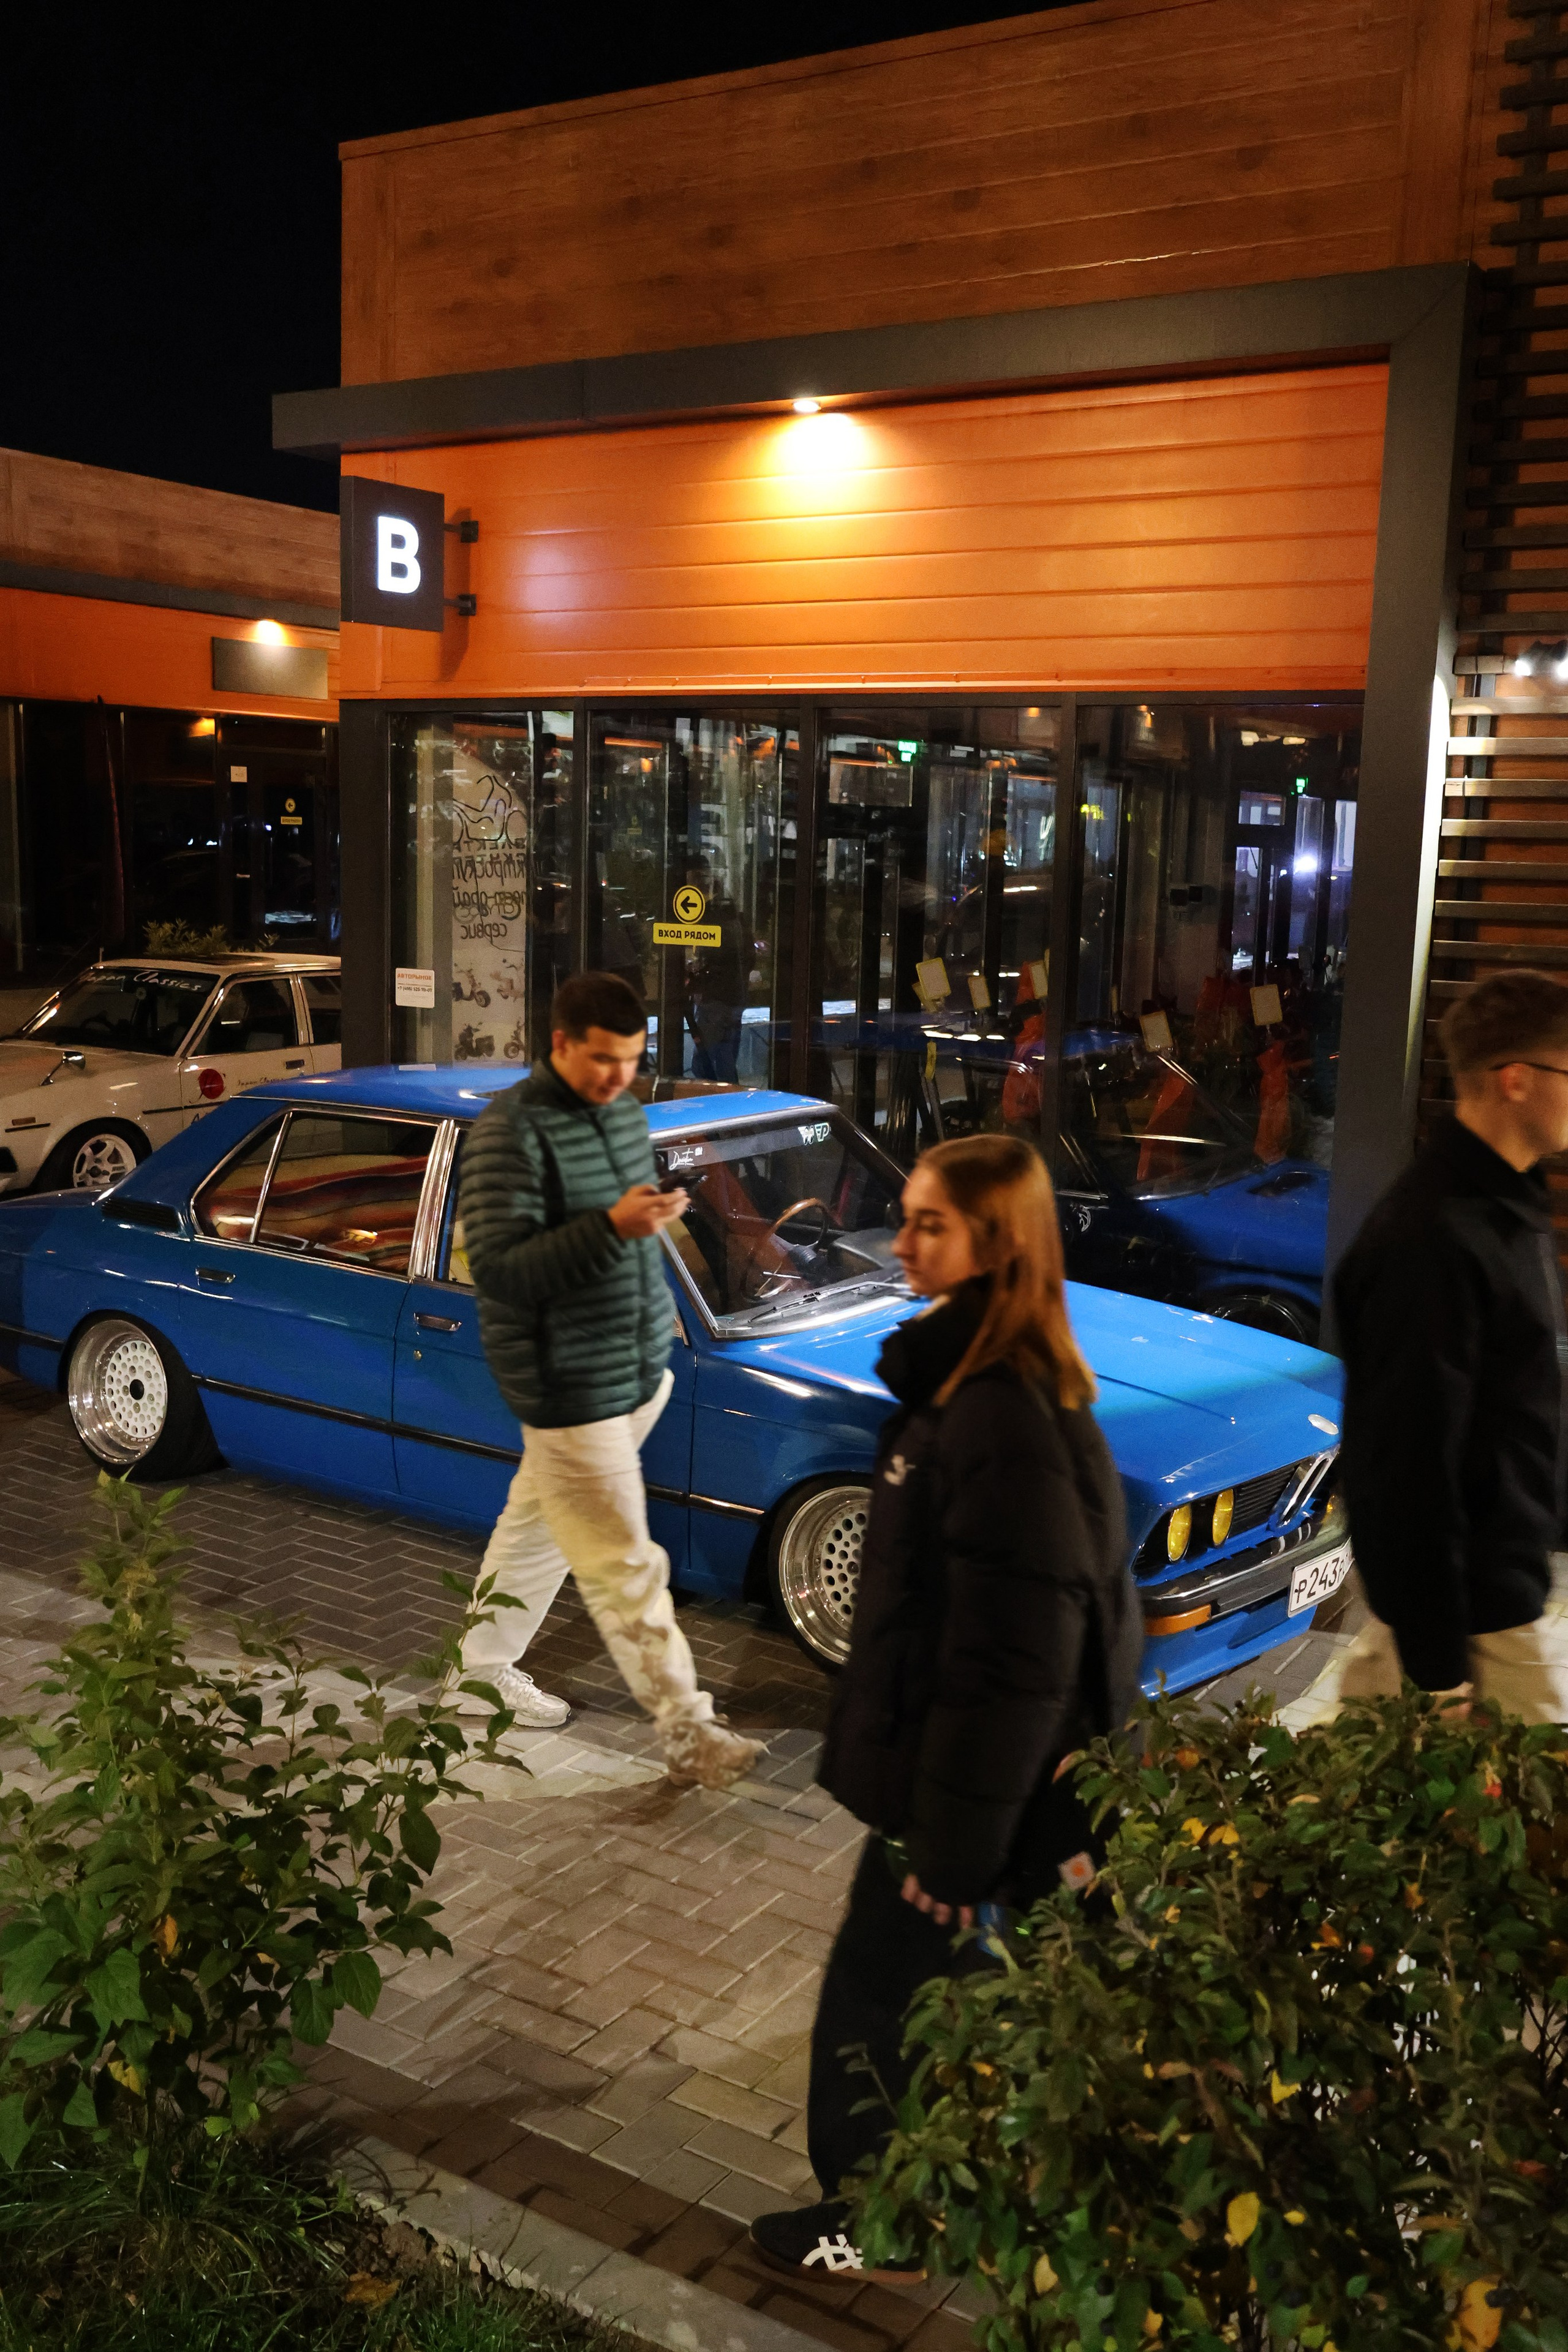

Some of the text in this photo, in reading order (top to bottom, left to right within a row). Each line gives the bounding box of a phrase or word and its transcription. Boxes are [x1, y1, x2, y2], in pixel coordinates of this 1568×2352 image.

[658, 929, 715, 940] ВХОД РЯДОМ
[134, 971, 202, 991] Classics
